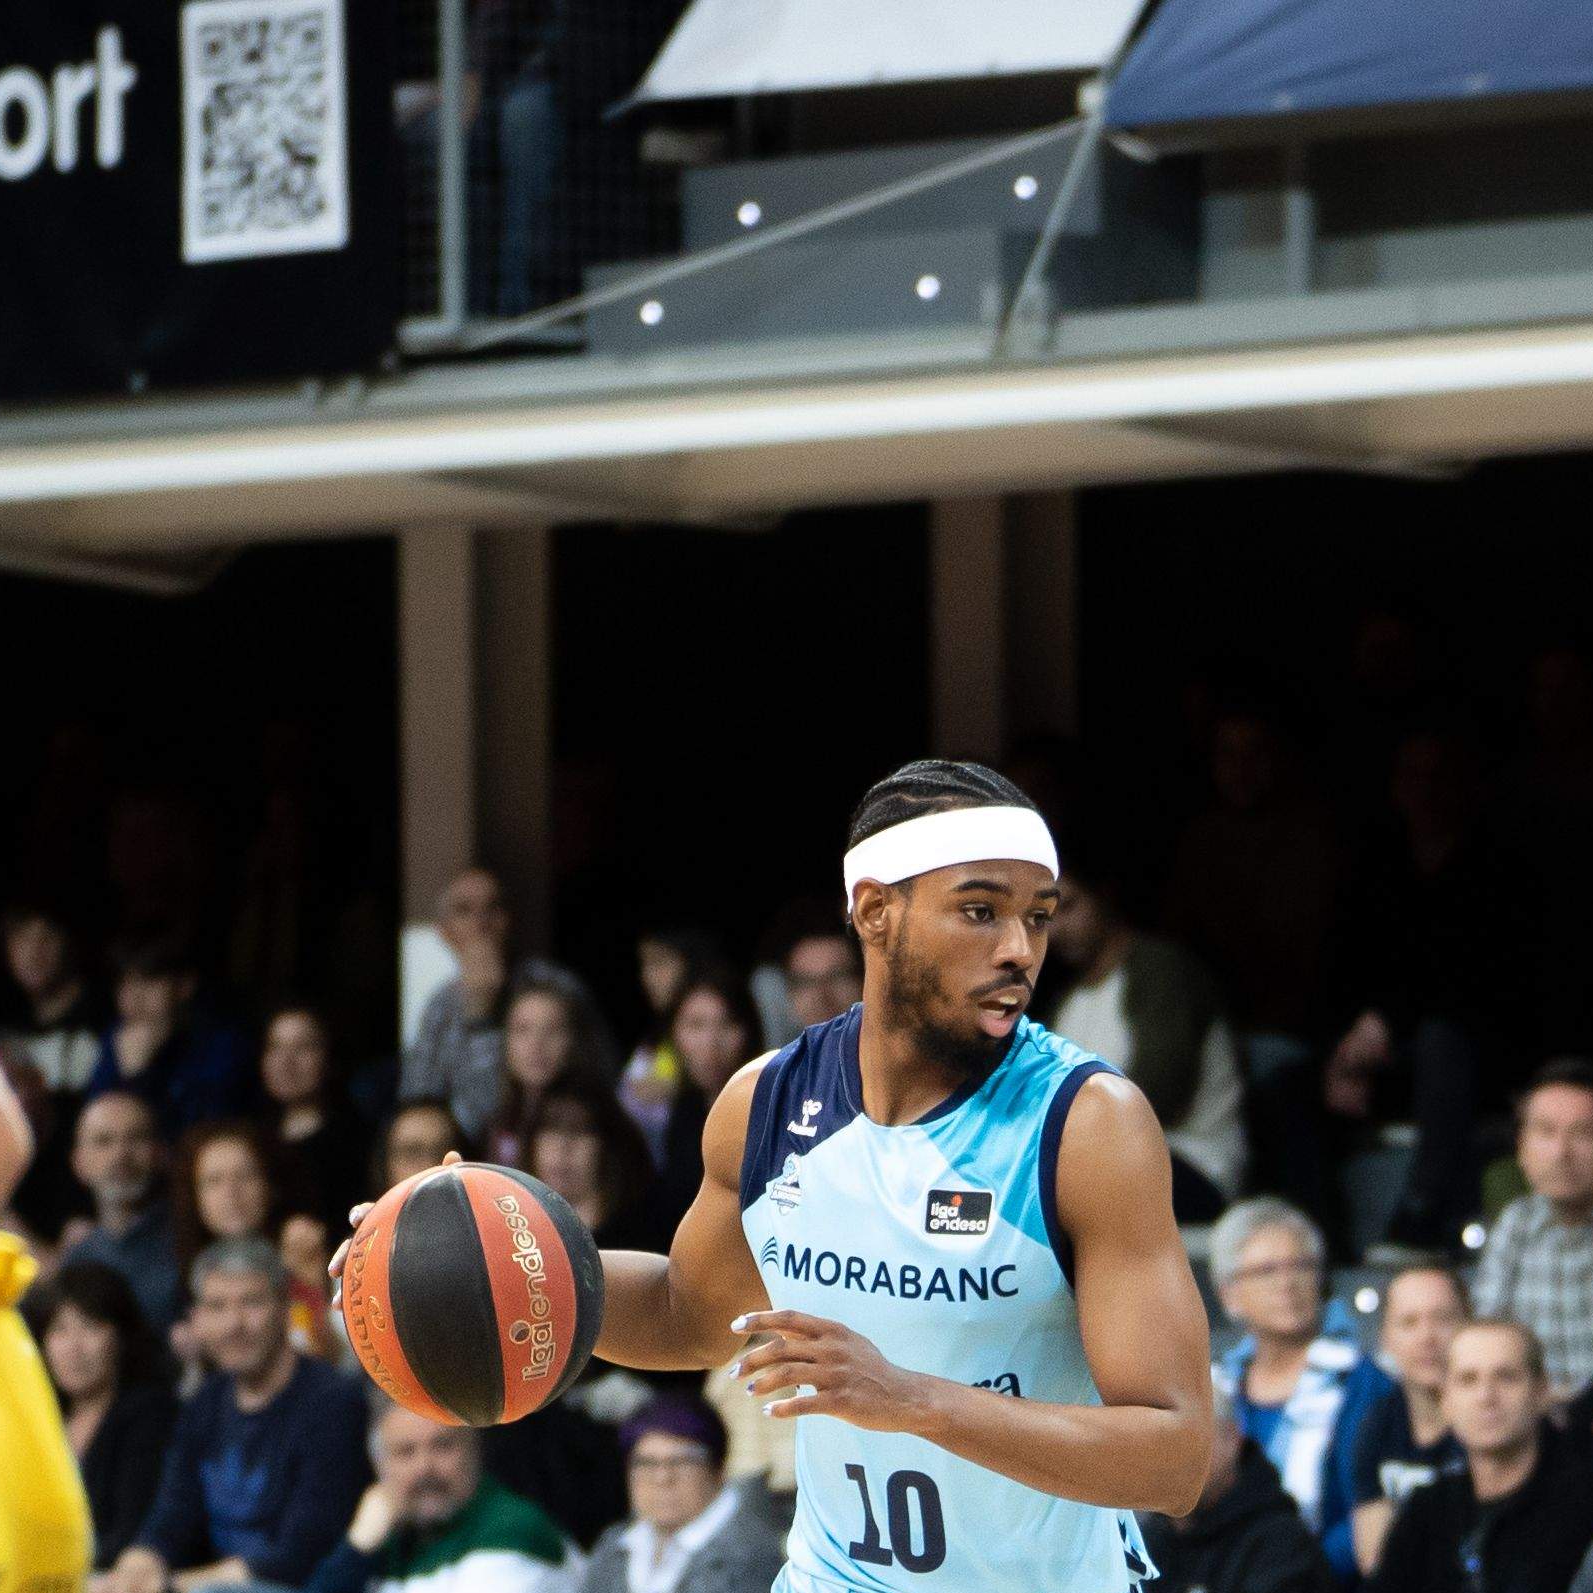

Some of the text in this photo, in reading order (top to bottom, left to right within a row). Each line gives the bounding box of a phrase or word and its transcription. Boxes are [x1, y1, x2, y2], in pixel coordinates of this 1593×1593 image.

[929, 1217, 987, 1232] endesa
[931, 1202, 959, 1219] liga
[497, 1195, 557, 1381] liga endesa
[783, 1243, 1020, 1303] MORABANC
[845, 1462, 947, 1573] 10
